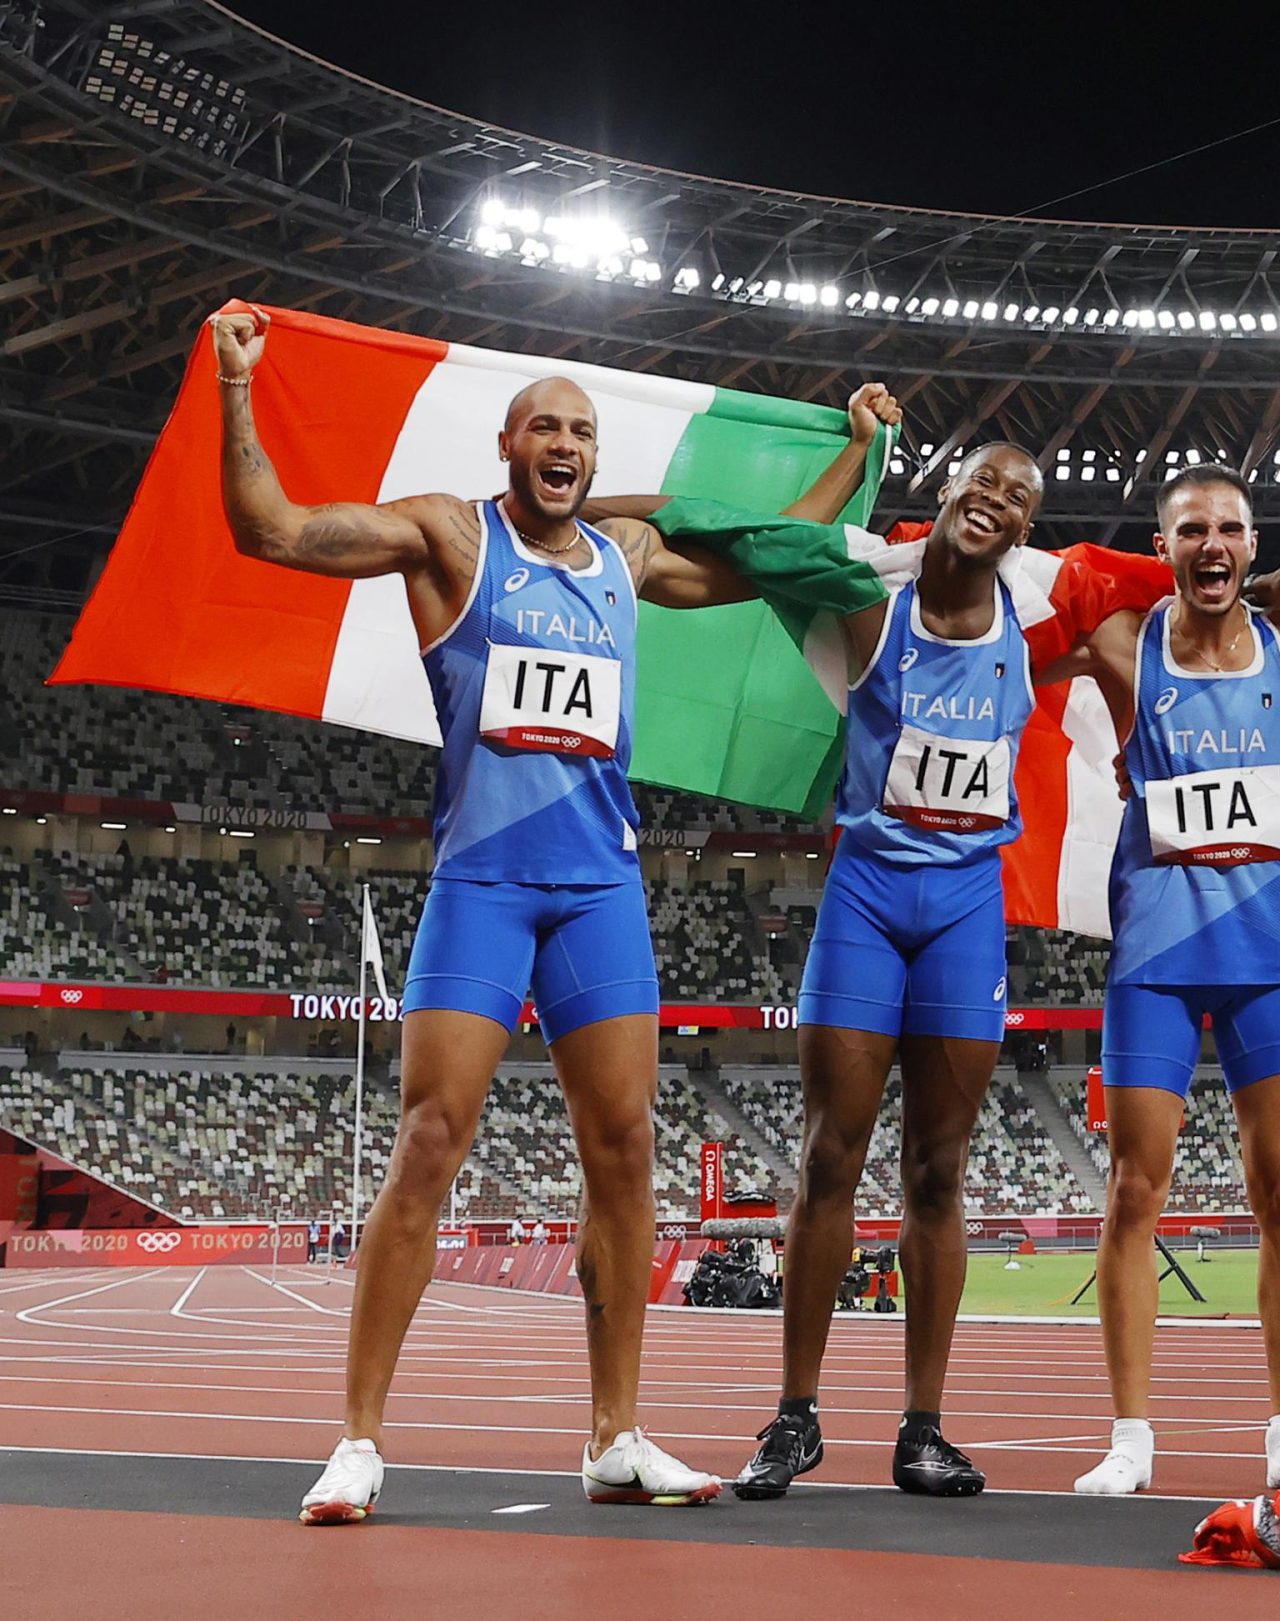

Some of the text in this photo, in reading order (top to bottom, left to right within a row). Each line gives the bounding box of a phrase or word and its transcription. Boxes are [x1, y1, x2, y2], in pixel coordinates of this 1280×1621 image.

[517, 609, 616, 648] ITALIA
[513, 660, 592, 719] ITA
[902, 691, 995, 720] ITALIA
[522, 732, 543, 743] TOKYO
[1168, 728, 1266, 754] ITALIA
[915, 745, 988, 799] ITA
[202, 805, 307, 829] TOKYO 2020
[1175, 781, 1257, 833] ITA
[642, 829, 686, 847] 2020
[369, 997, 404, 1021] 20
[705, 1165, 716, 1202] OMEGA
[11, 1234, 128, 1252] TOK 2020
[191, 1232, 305, 1250] TOKYO 2020
